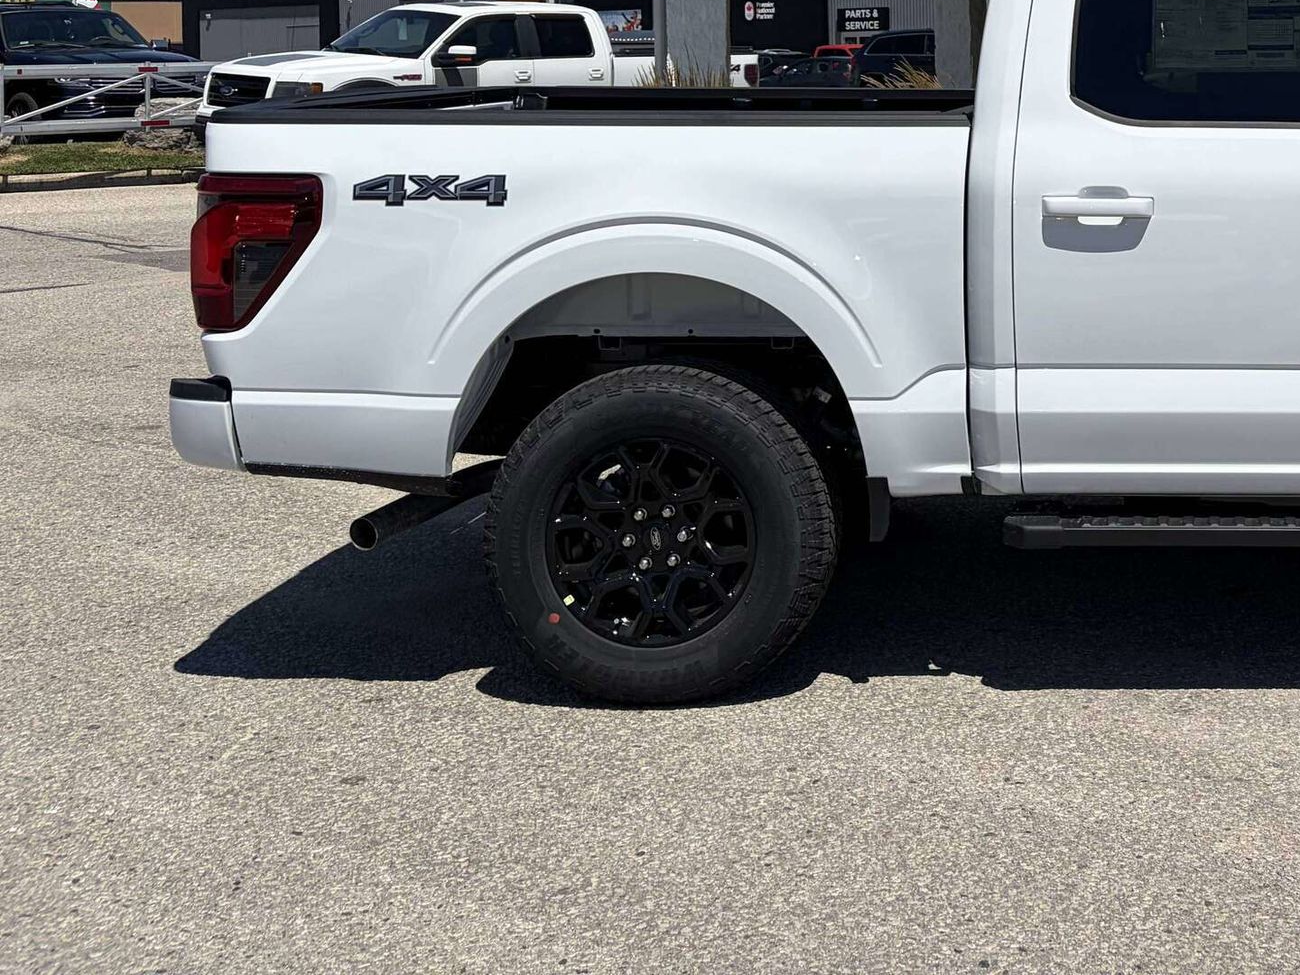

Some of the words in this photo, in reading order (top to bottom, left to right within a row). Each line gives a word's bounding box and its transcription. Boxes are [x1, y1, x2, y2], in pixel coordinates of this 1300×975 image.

[845, 9, 871, 18] PARTS
[872, 9, 879, 17] &
[845, 20, 880, 30] SERVICE
